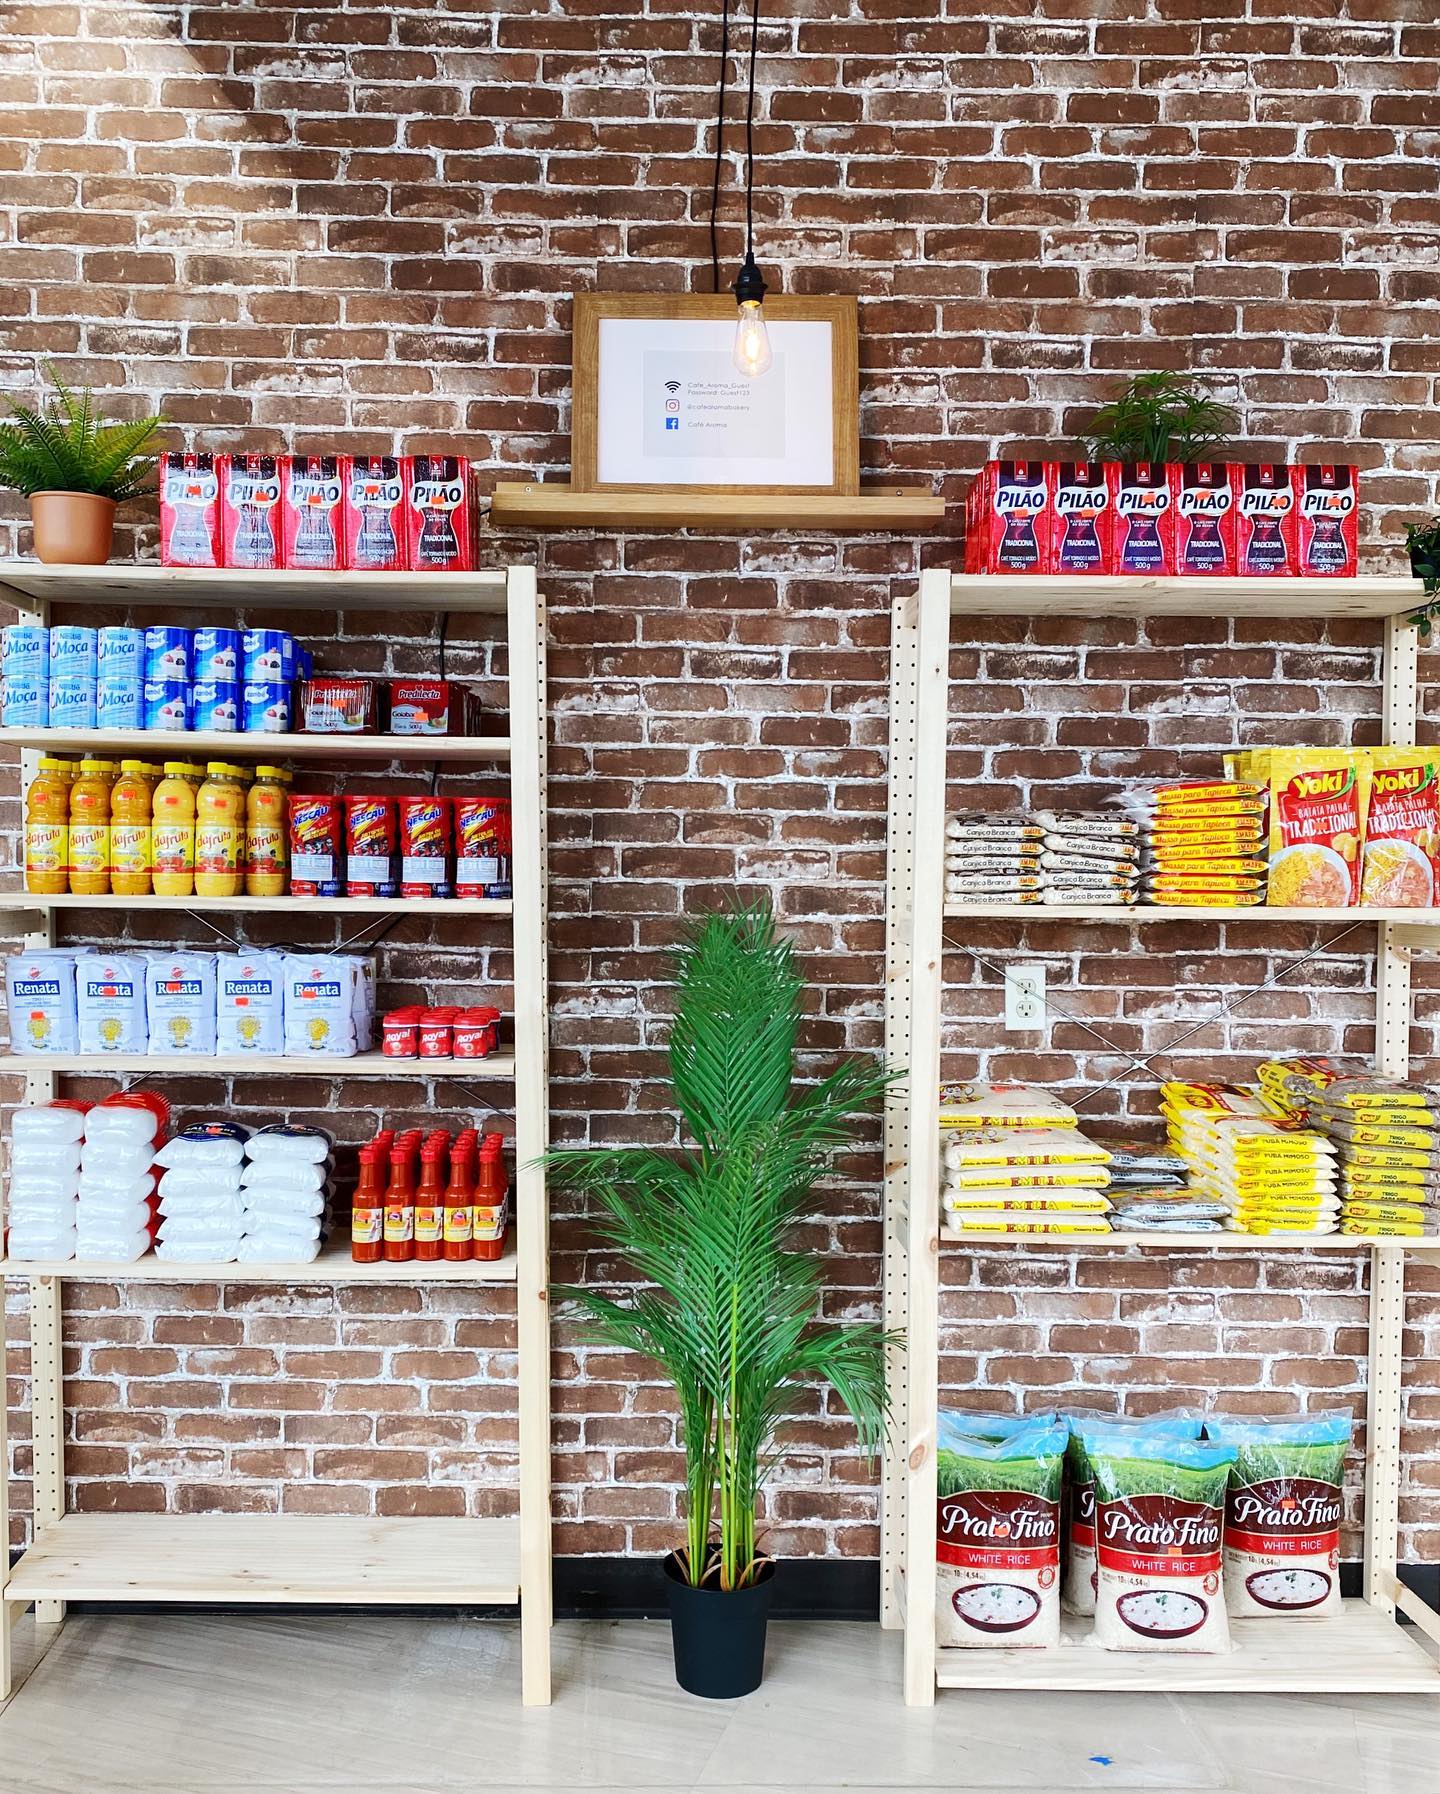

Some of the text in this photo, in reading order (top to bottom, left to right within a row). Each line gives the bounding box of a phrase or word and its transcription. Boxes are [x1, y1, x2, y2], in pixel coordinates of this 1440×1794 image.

[996, 490, 1044, 508] PILÃO
[1057, 491, 1105, 508] PILÃO
[8, 641, 39, 655] Moça
[56, 641, 88, 655] Moça
[104, 642, 134, 656] Moça
[6, 691, 37, 704] Moça
[56, 692, 87, 705] Moça
[103, 692, 134, 706] Moça
[398, 689, 440, 699] Predilecta
[1292, 770, 1344, 798] Yoki
[1373, 769, 1419, 794] Yoki
[1298, 803, 1348, 818] BATATA PALHA
[1405, 798, 1427, 810] PALHA
[294, 806, 329, 826] NESCAU
[351, 807, 385, 826] NESCAU
[406, 808, 442, 827] NESCAU
[460, 808, 495, 828] NESCAU
[70, 830, 104, 848] dafruta
[112, 830, 146, 848] dafruta
[154, 831, 189, 849] dafruta
[197, 831, 230, 849] dafruta
[1084, 861, 1108, 869] Branca
[16, 982, 58, 995] Renata
[226, 982, 270, 994] Renata
[981, 1116, 1034, 1126] EMILIA
[1006, 1155, 1061, 1166] EMILIA
[1011, 1176, 1065, 1187] EMILIA
[1003, 1201, 1059, 1210] EMILIA
[1006, 1224, 1061, 1233] EMILIA
[1234, 1496, 1339, 1527] Prato Fino
[1010, 1510, 1054, 1540] Fino
[1104, 1511, 1218, 1547] Prato Fino
[1263, 1540, 1322, 1550] WHITE RICE
[968, 1553, 1031, 1564] WHITE RICE
[1132, 1560, 1196, 1572] WHITE RICE
